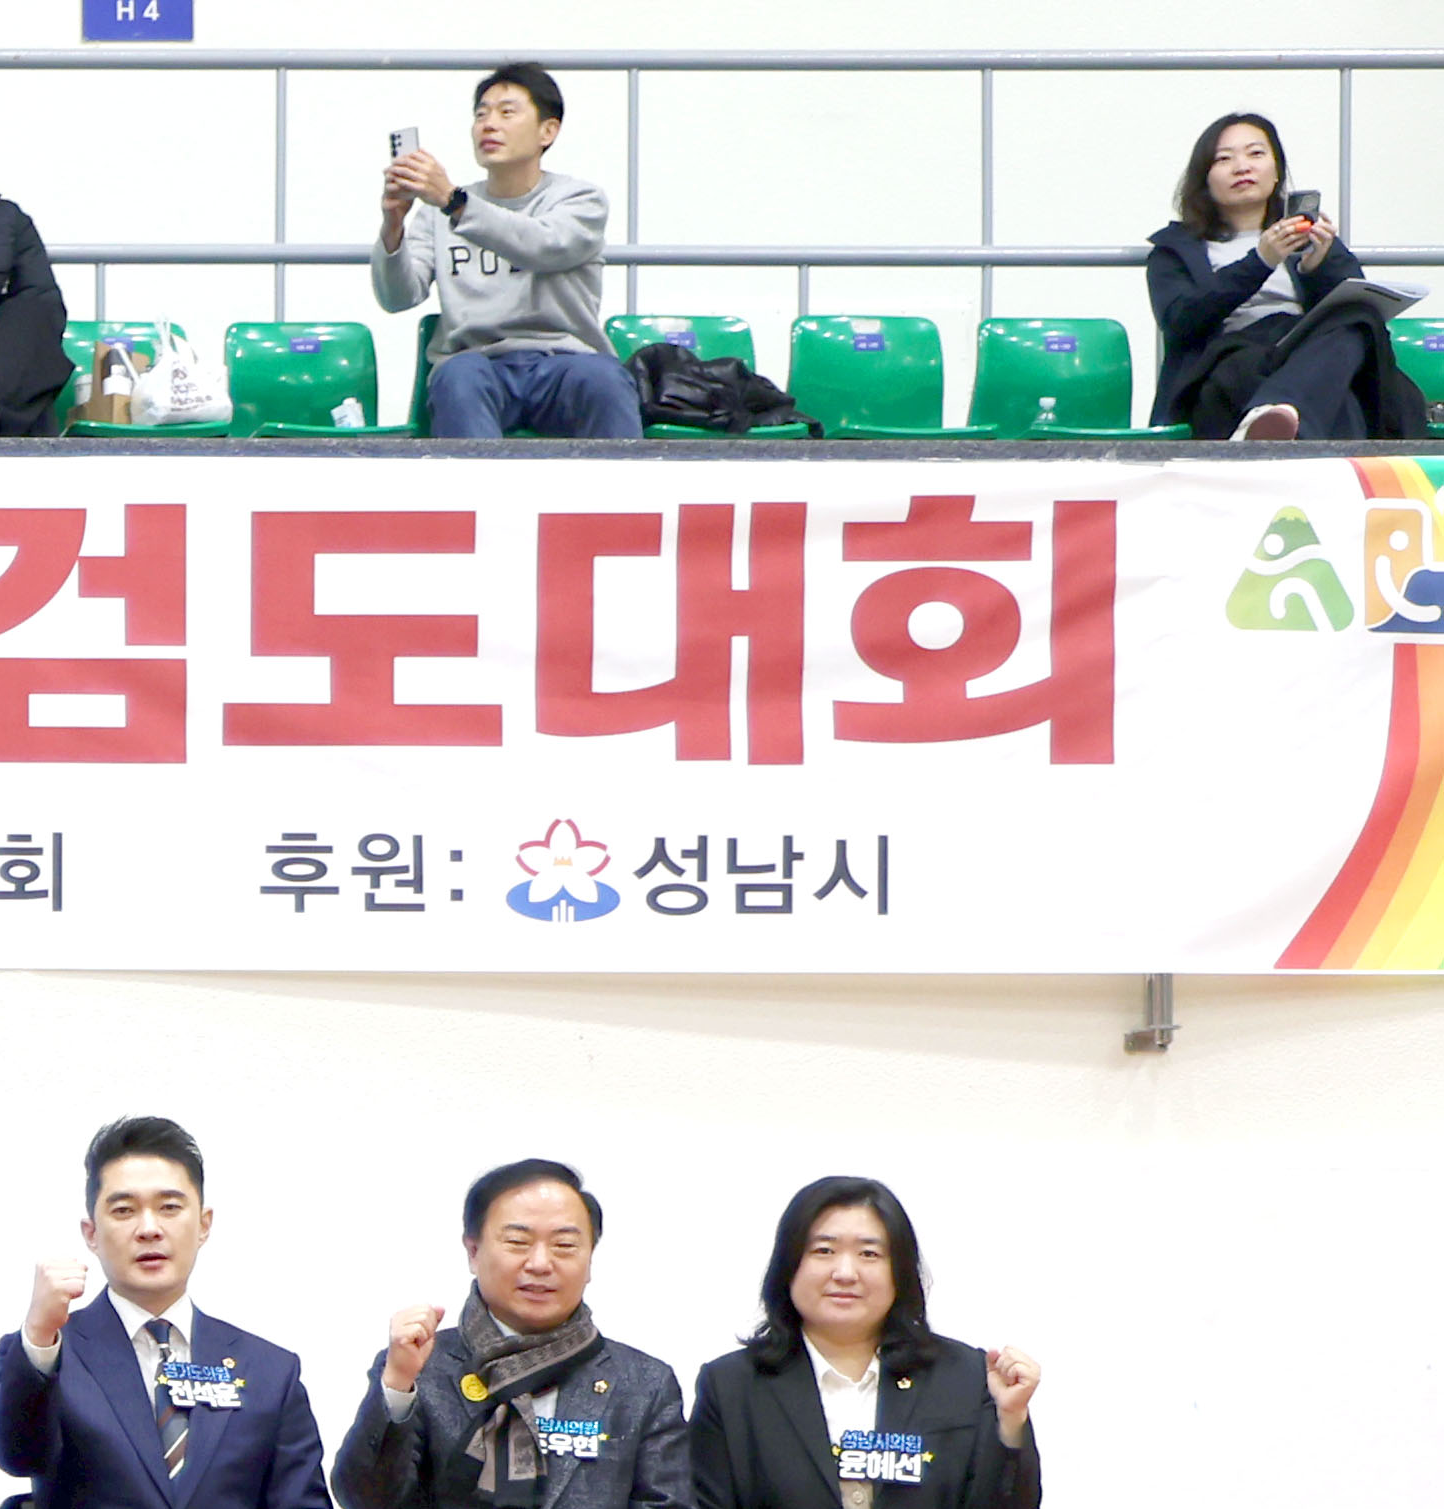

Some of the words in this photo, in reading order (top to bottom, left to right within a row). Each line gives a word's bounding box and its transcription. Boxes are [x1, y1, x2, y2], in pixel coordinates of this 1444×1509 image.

[117, 0, 134, 21] H
[143, 0, 160, 21] 4
[261, 833, 464, 912] 후원:
[632, 834, 889, 921] 성남시
[536, 1417, 599, 1435] 남시의원
[842, 1431, 922, 1453] 성남시의원
[839, 1450, 922, 1482] 윤혜선
